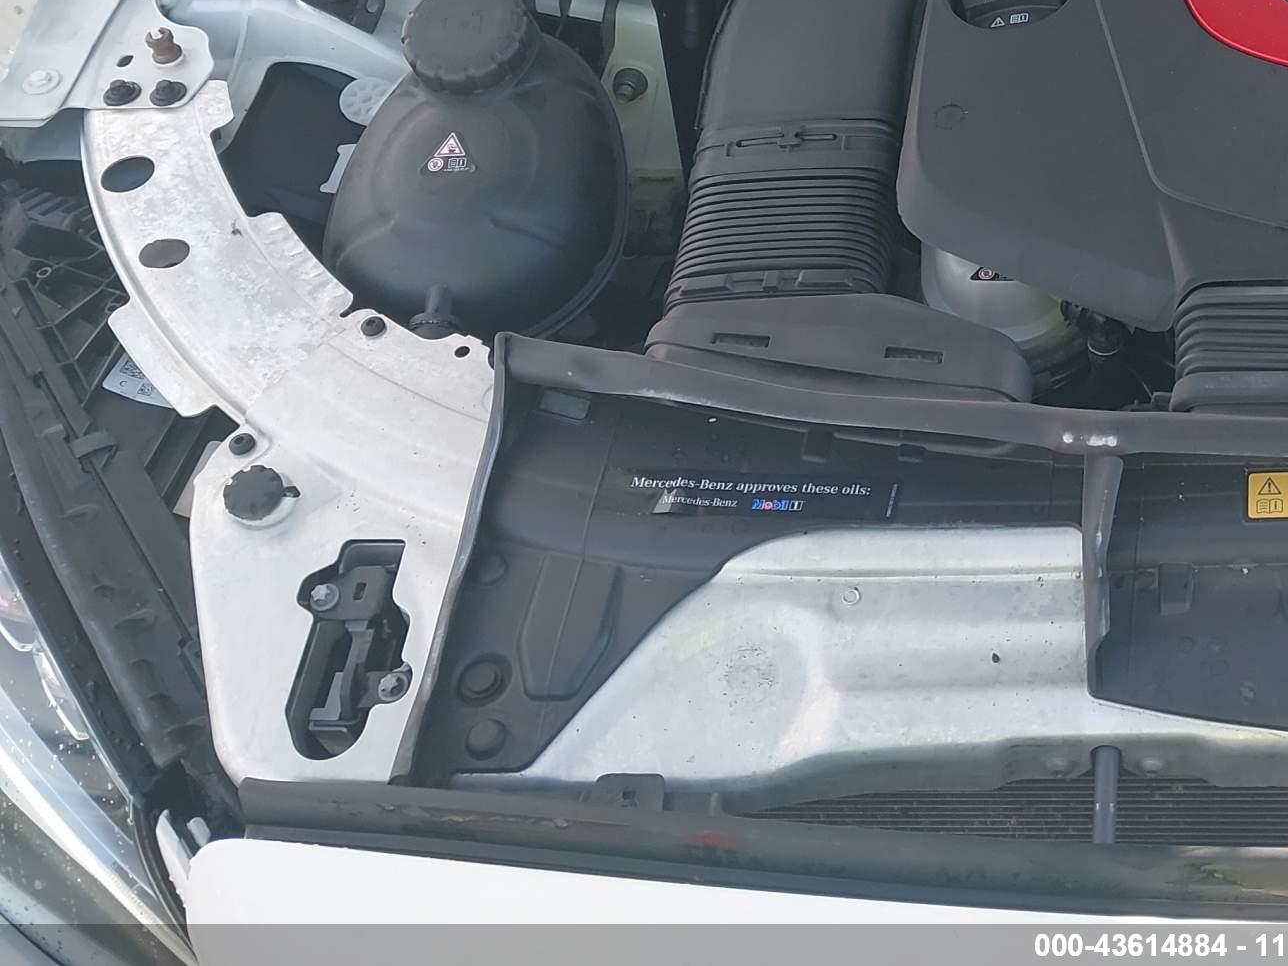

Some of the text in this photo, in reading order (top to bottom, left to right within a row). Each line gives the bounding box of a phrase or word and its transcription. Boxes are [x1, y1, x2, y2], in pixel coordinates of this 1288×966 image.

[630, 476, 871, 495] Mercedes-Benz approves these oils:
[752, 498, 788, 510] Mobil
